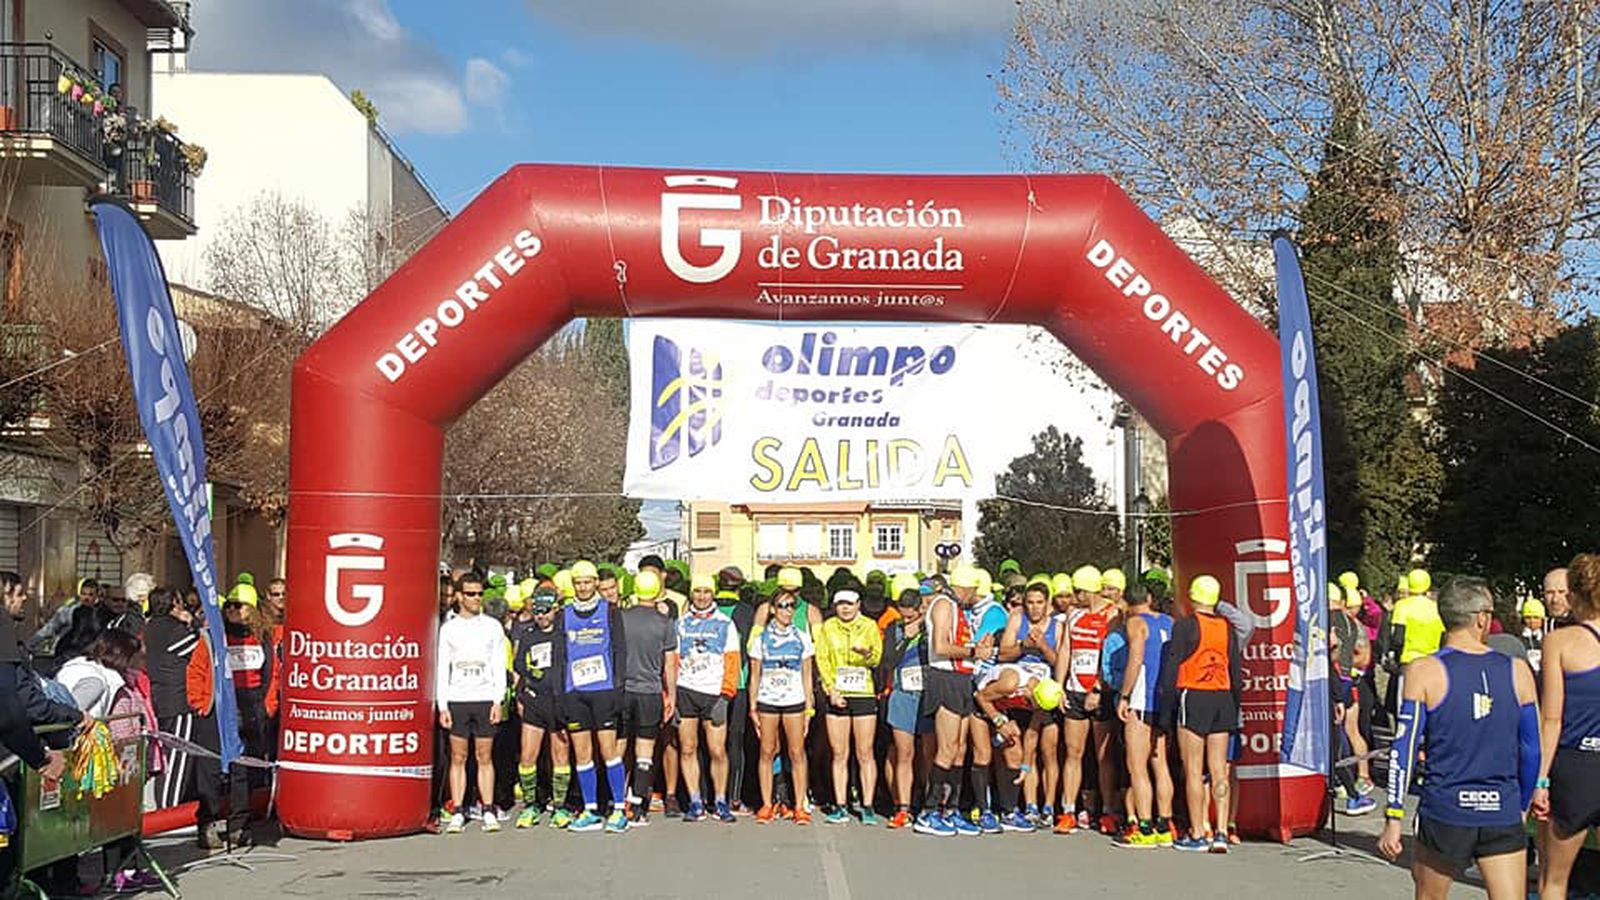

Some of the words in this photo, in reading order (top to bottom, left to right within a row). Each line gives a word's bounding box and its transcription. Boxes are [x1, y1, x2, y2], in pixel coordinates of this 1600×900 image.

[757, 195, 966, 234] Diputación
[758, 235, 800, 269] de
[807, 236, 965, 270] Granada
[375, 230, 542, 382] DEPORTES
[756, 289, 871, 305] Avanzamos
[873, 291, 945, 307] junt@s
[1086, 239, 1244, 390] DEPORTES
[762, 332, 956, 387] olimpo
[755, 380, 884, 405] deportes
[812, 411, 901, 428] Granada
[750, 434, 973, 492] SALIDA
[290, 631, 420, 663] Diputación
[288, 662, 309, 687] de
[312, 664, 418, 690] Granada
[289, 704, 364, 721] Avanzamos
[284, 729, 419, 755] DEPORTES
